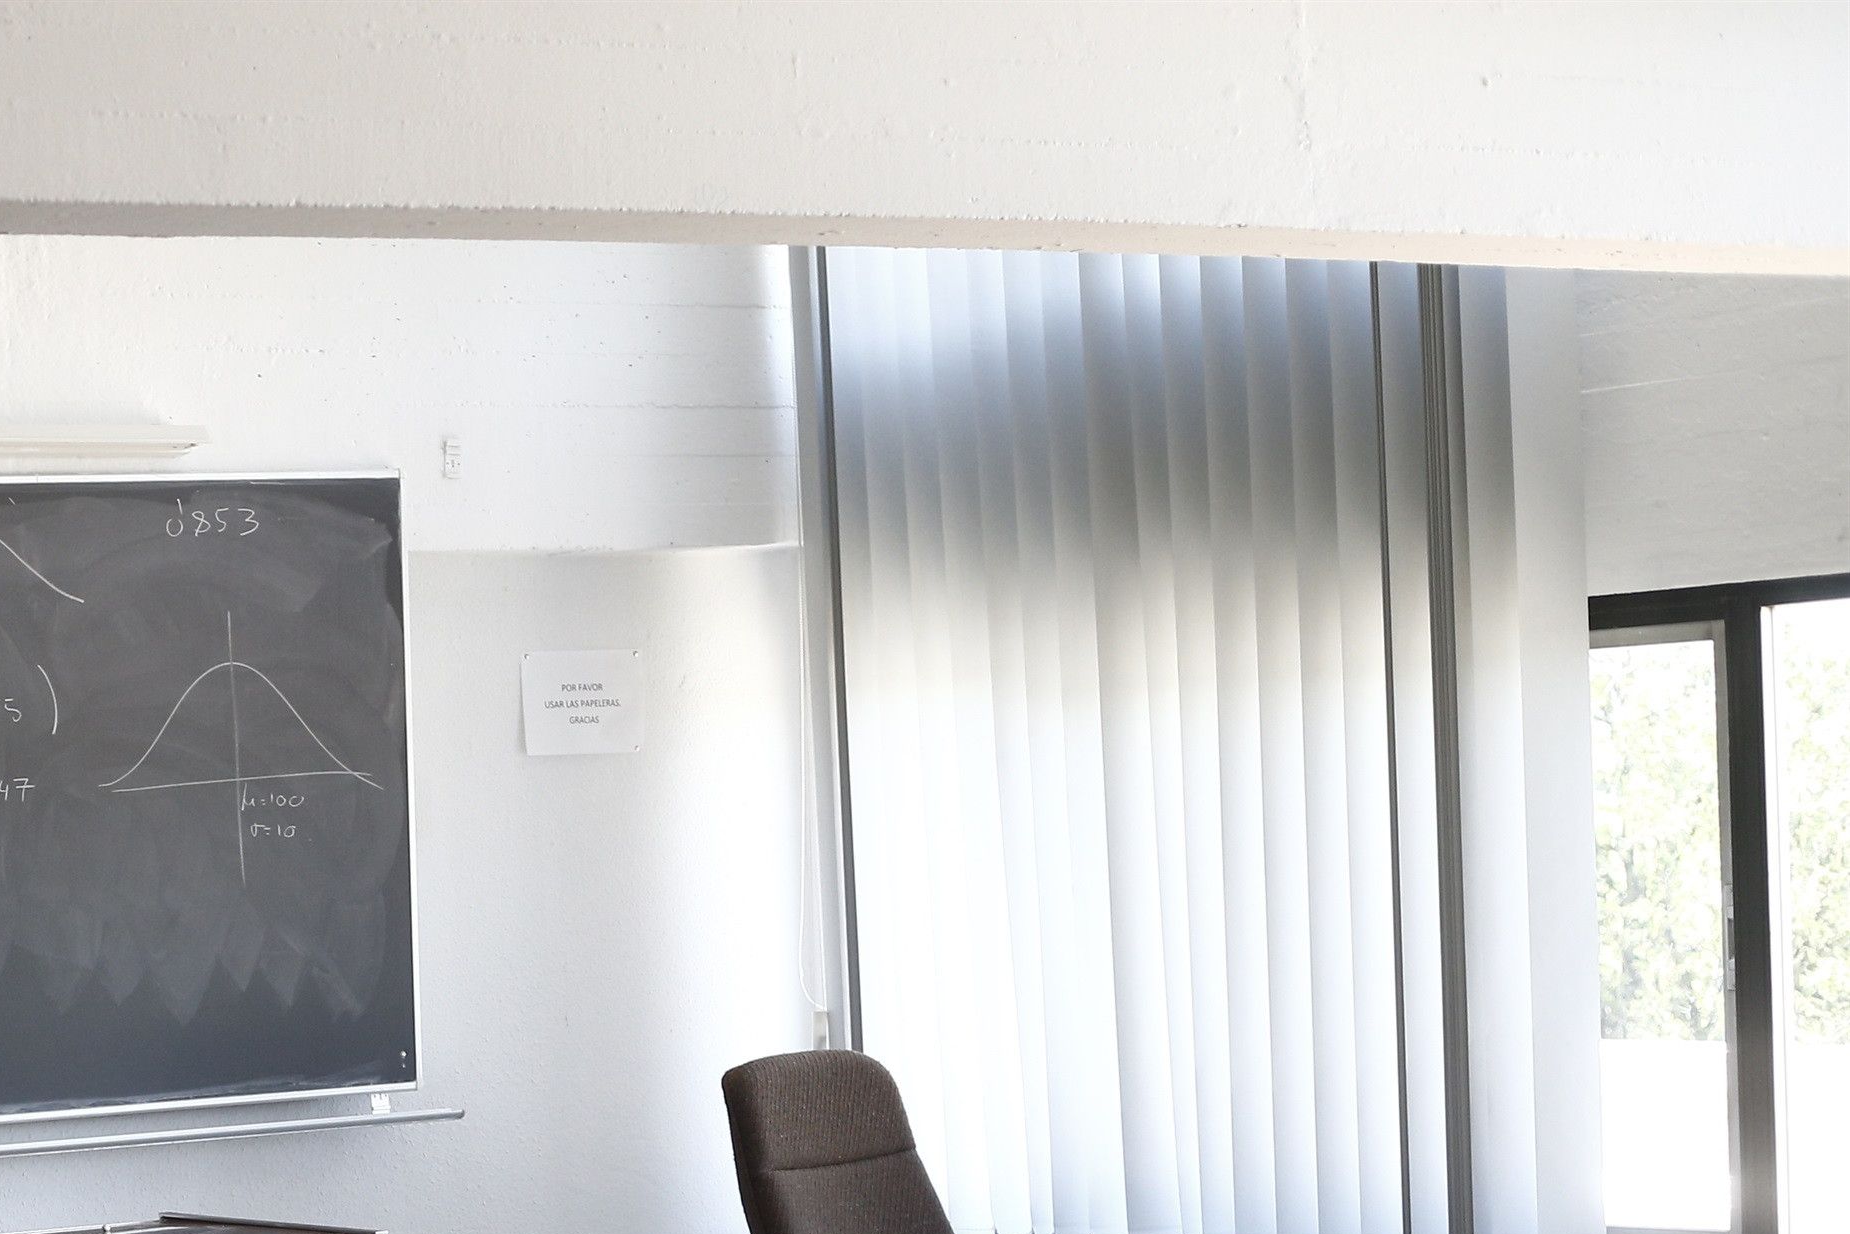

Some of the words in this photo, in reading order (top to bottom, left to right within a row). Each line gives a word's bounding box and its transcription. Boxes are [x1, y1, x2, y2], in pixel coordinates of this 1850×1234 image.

[561, 683, 577, 692] POR
[578, 682, 604, 692] FAVOR
[544, 700, 565, 709] USAR
[565, 699, 579, 708] LAS
[569, 715, 600, 725] GRACIAS
